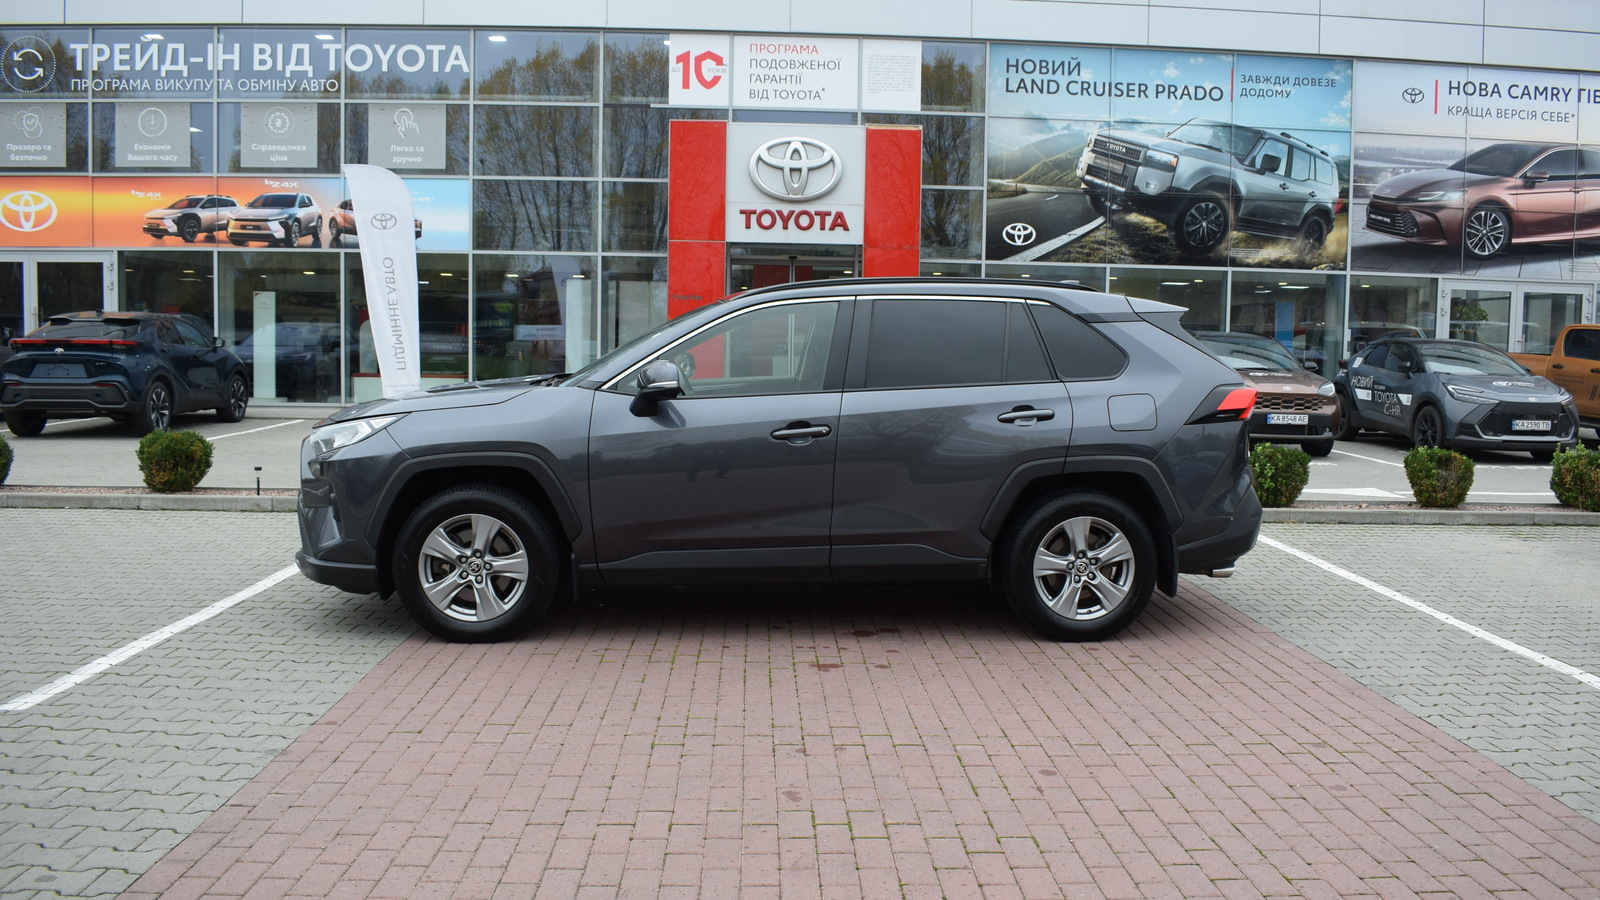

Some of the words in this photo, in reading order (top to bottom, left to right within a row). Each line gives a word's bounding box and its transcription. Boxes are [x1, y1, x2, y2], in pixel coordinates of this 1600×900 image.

[750, 43, 819, 55] ПРОГРАМА
[70, 35, 240, 77] ТРЕЙД-ІН
[253, 43, 313, 77] ВІД
[322, 44, 470, 73] TOYOTA
[676, 50, 723, 90] 10
[749, 58, 842, 70] ПОДОВЖЕНОЇ
[1006, 57, 1081, 76] НОВИЙ
[749, 72, 803, 85] ГАРАНТІЇ
[1240, 74, 1290, 86] ЗАВЖДИ
[1293, 77, 1336, 88] ДОВЕЗЕ
[71, 79, 151, 91] ПРОГРАМА
[156, 79, 213, 91] ВИКУПУ
[216, 79, 233, 91] ТА
[238, 79, 299, 92] ОБМІНУ
[300, 80, 339, 92] АВТО
[1005, 77, 1060, 95] LAND
[1066, 80, 1149, 99] CRUISER
[1155, 84, 1224, 102] PRADO
[1448, 80, 1502, 98] НОВА
[1507, 84, 1573, 103] CAMRY
[749, 89, 769, 101] ВІД
[1239, 87, 1292, 99] ДОДОМУ
[1447, 106, 1493, 120] КРАЩА
[1496, 108, 1537, 121] ВЕРСІЯ
[7, 143, 40, 152] Прозоро
[134, 143, 171, 151] Економія
[251, 143, 307, 153] Справедлива
[1106, 143, 1126, 153] TOYOTA
[10, 153, 48, 161] безпечно
[128, 153, 157, 161] Вашого
[159, 154, 178, 162] часу
[270, 154, 288, 163] ціна
[392, 155, 422, 164] зручно
[739, 209, 850, 231] TOYOTA
[1350, 375, 1374, 388] НОВИЙ
[1374, 390, 1399, 404] TOYOTA
[1383, 403, 1401, 416] C-HR
[1525, 421, 1540, 429] 2590
[1542, 421, 1550, 429] TB
